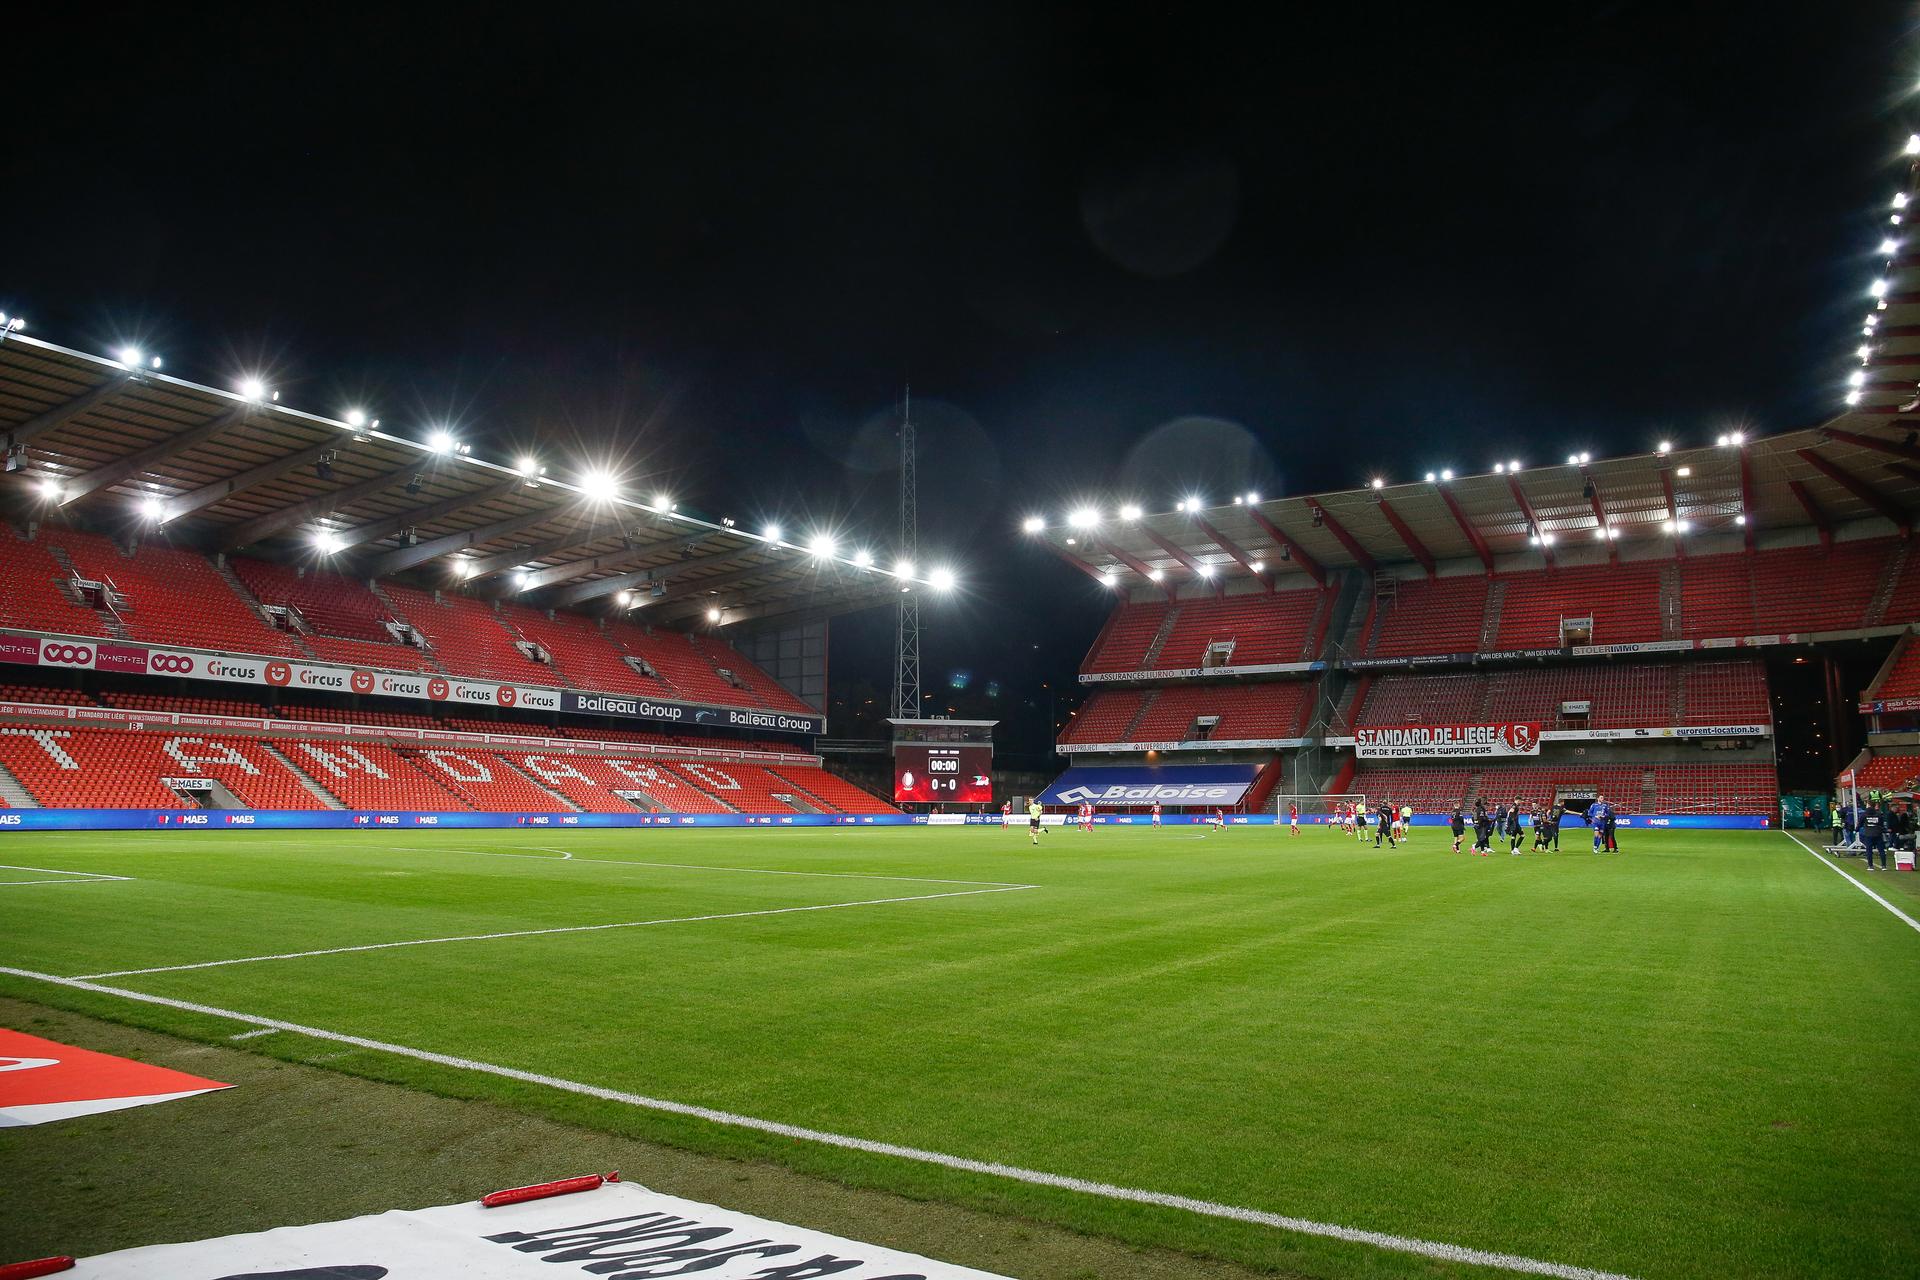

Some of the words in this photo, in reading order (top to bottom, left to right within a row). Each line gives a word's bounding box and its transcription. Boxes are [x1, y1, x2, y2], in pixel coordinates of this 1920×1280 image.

[207, 660, 256, 678] Circus
[299, 669, 343, 687] Circus
[382, 678, 421, 694] Circus
[456, 685, 491, 701] Circus
[522, 692, 554, 707] Circus
[577, 695, 637, 715] Balleau
[640, 703, 682, 720] Group
[730, 711, 776, 728] Balleau
[778, 716, 811, 732] Group
[1358, 728, 1430, 747] STANDARD
[1434, 727, 1453, 746] DE
[1456, 726, 1496, 745] LIEGE
[1676, 725, 1760, 737] eurorent-location.be
[1141, 742, 1176, 750] LIVEPROJECT
[1391, 748, 1413, 756] FOOT
[1415, 747, 1436, 755] SANS
[1437, 746, 1492, 755] SUPPORTERS
[931, 760, 957, 771] 00:00
[178, 779, 203, 789] MAES
[931, 778, 939, 791] 0
[949, 778, 956, 791] 0
[1101, 784, 1229, 800] Baloise
[183, 815, 209, 825] MAES
[231, 815, 256, 825] MAES
[380, 815, 400, 825] MAES
[419, 816, 439, 825] MAES
[532, 816, 550, 825] MAES
[562, 816, 579, 825] MAES
[1650, 818, 1669, 826] MAES
